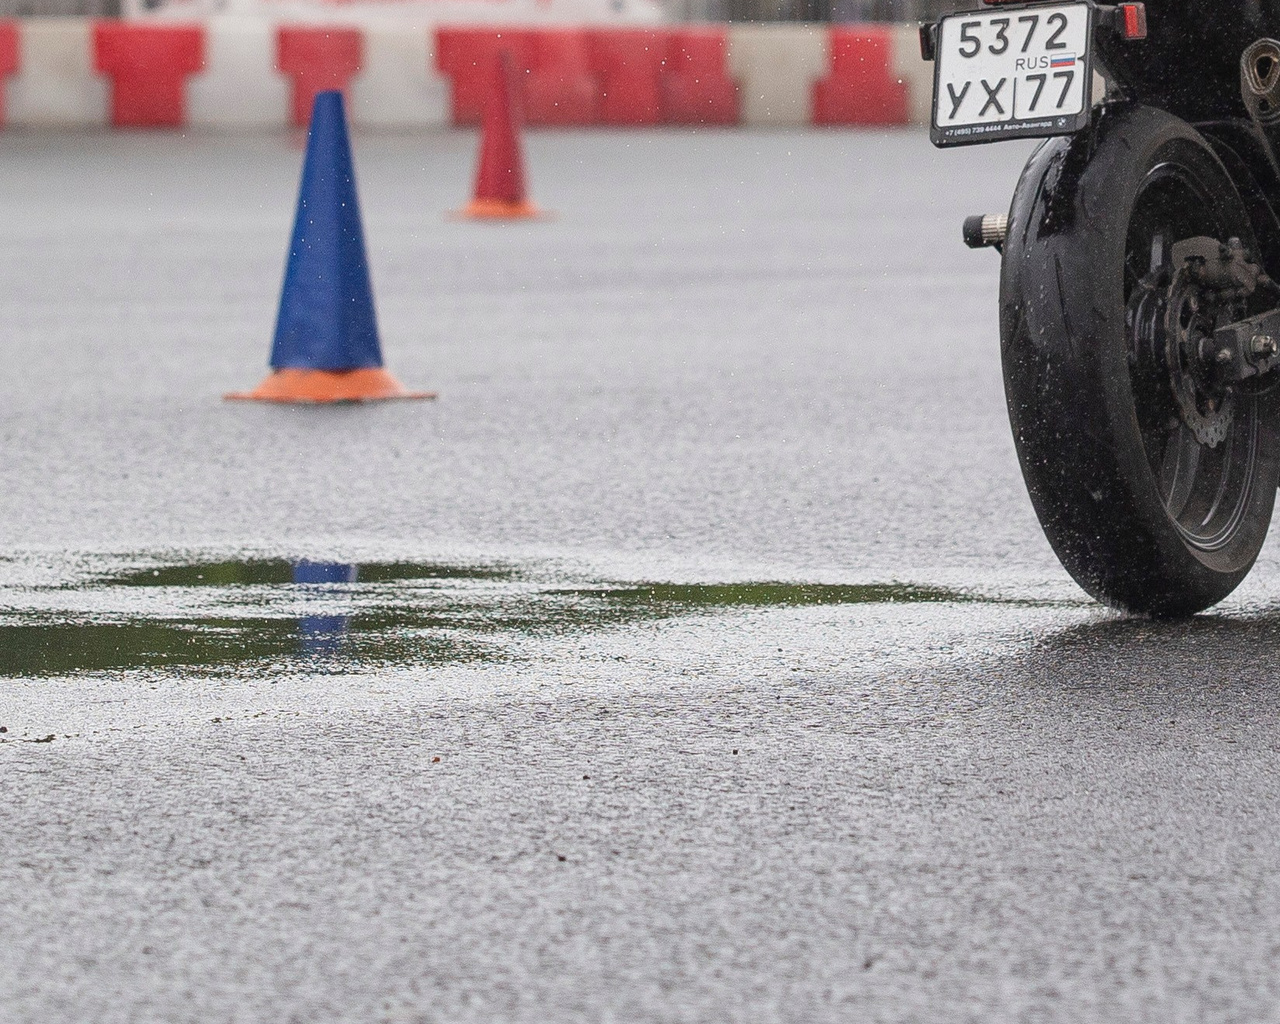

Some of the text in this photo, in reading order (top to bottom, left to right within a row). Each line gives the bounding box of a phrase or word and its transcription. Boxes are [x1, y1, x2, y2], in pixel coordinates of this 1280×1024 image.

[958, 12, 1068, 58] 5372
[1015, 56, 1049, 71] RUS
[1025, 70, 1075, 112] 77
